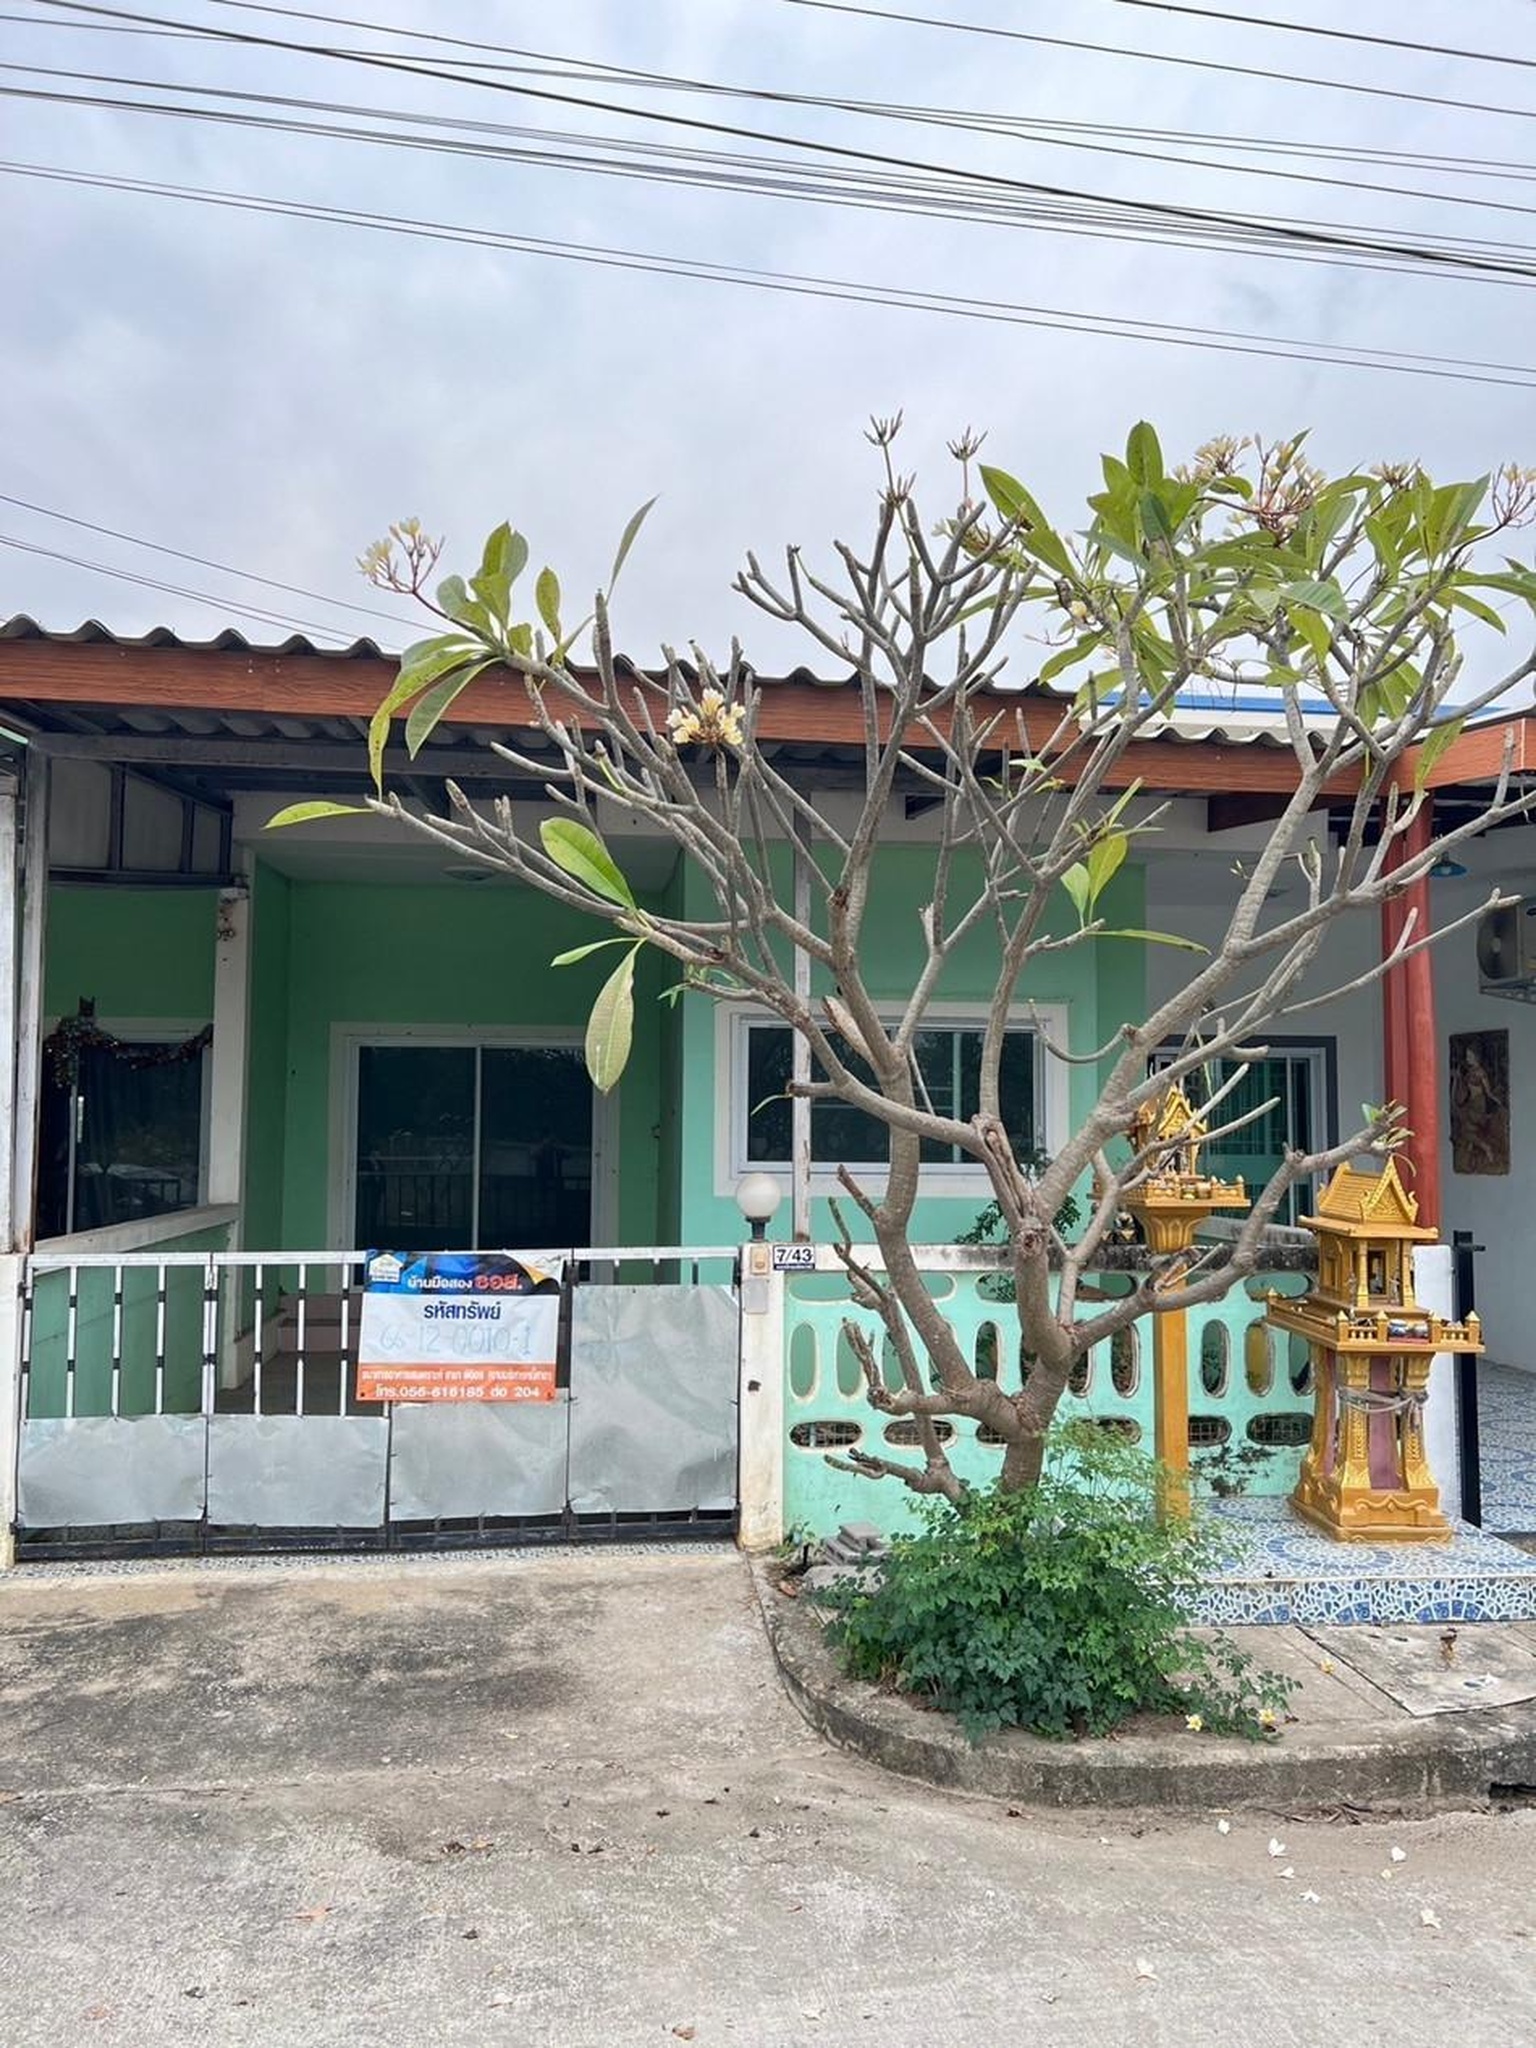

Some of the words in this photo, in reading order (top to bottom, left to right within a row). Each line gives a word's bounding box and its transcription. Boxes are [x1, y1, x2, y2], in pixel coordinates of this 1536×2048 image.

[776, 1247, 812, 1262] 7/43
[408, 1276, 473, 1289] บ้านมือสอง
[424, 1300, 501, 1319] รหัสทรัพย์
[514, 1386, 540, 1397] 204
